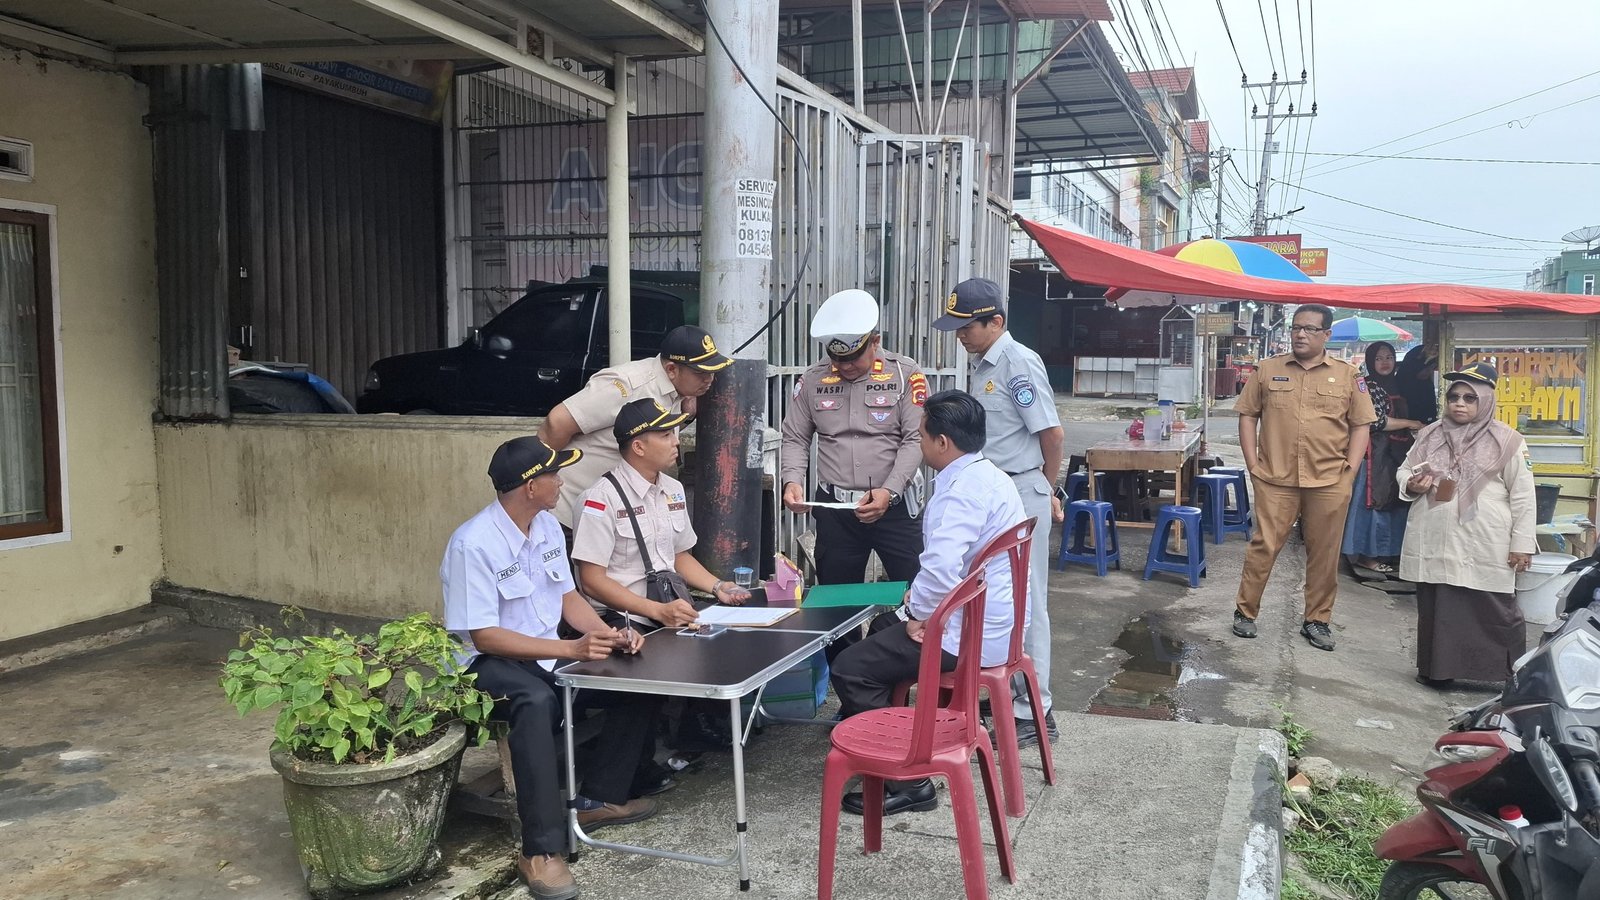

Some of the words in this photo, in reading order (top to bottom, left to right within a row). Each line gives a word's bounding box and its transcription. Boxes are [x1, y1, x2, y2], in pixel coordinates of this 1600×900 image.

[313, 74, 367, 97] PAYAKUMBUH
[816, 386, 844, 394] WASRI
[866, 383, 897, 391] POLRI
[629, 421, 649, 435] KORPRI
[521, 463, 543, 480] KORPRI
[1467, 836, 1497, 856] FI
